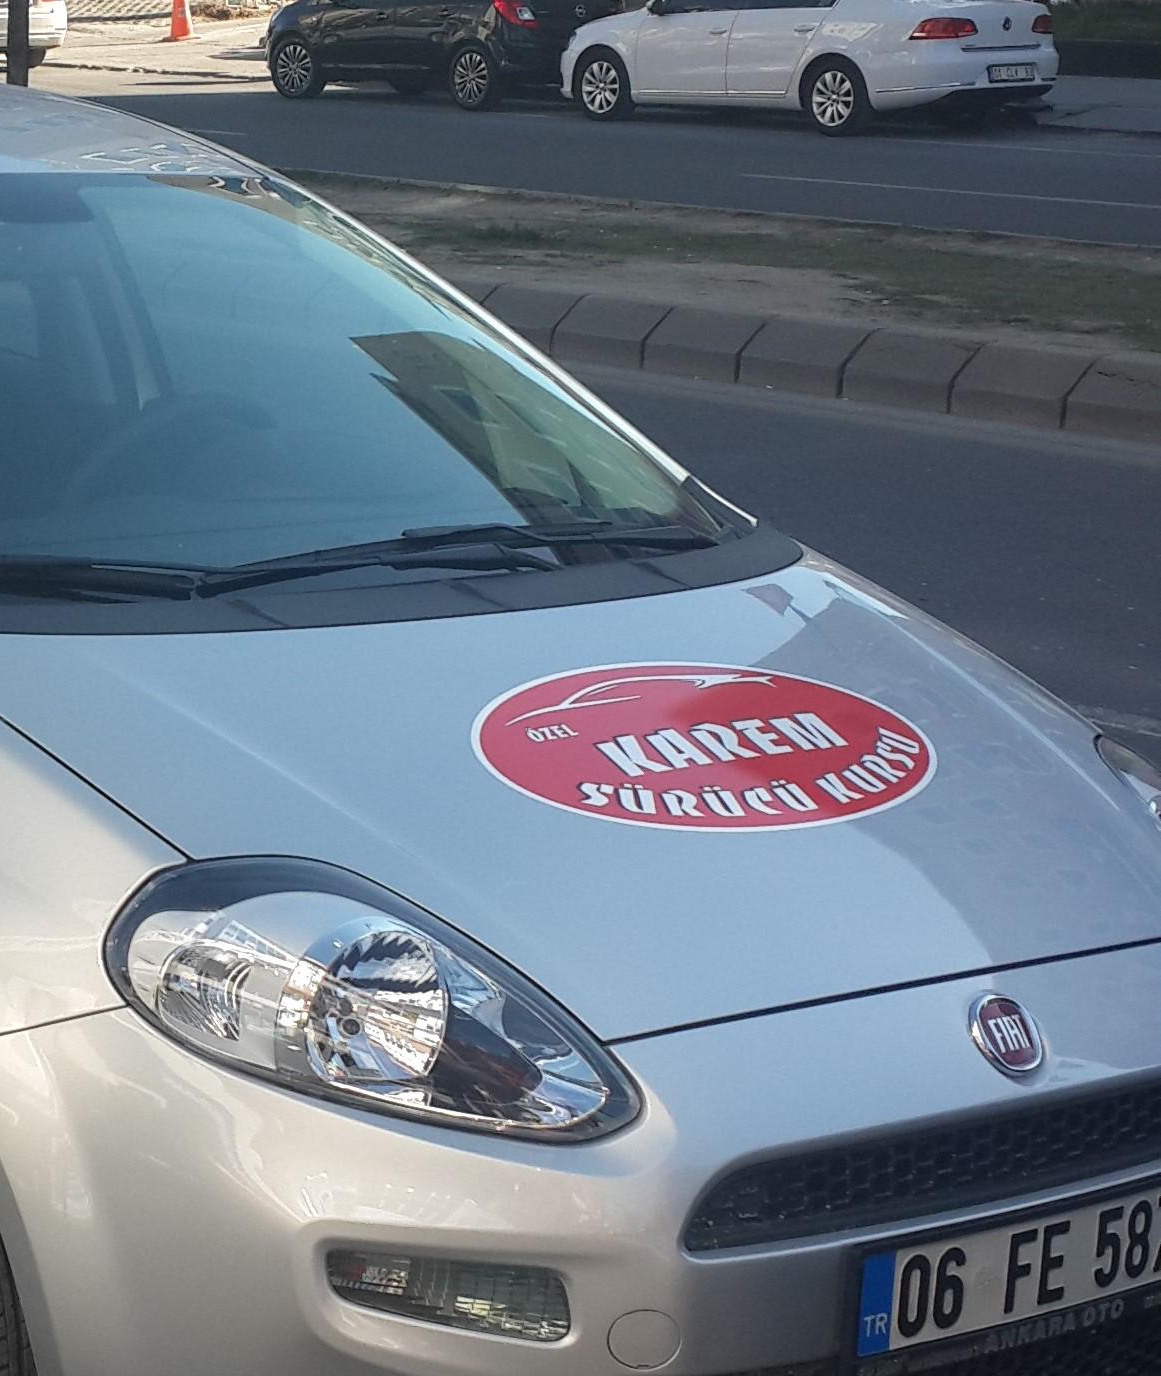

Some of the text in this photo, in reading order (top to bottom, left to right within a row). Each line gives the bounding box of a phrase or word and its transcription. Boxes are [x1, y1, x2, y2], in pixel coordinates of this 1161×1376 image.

[526, 724, 579, 743] ÖZEL
[596, 711, 849, 778] KAREM
[576, 726, 924, 818] SÜRÜCÜ KURSU
[988, 1014, 1030, 1054] FIAT
[896, 1246, 968, 1339] 06
[1003, 1220, 1072, 1315] FE
[863, 1313, 889, 1338] TR
[1082, 1298, 1126, 1328] OTO
